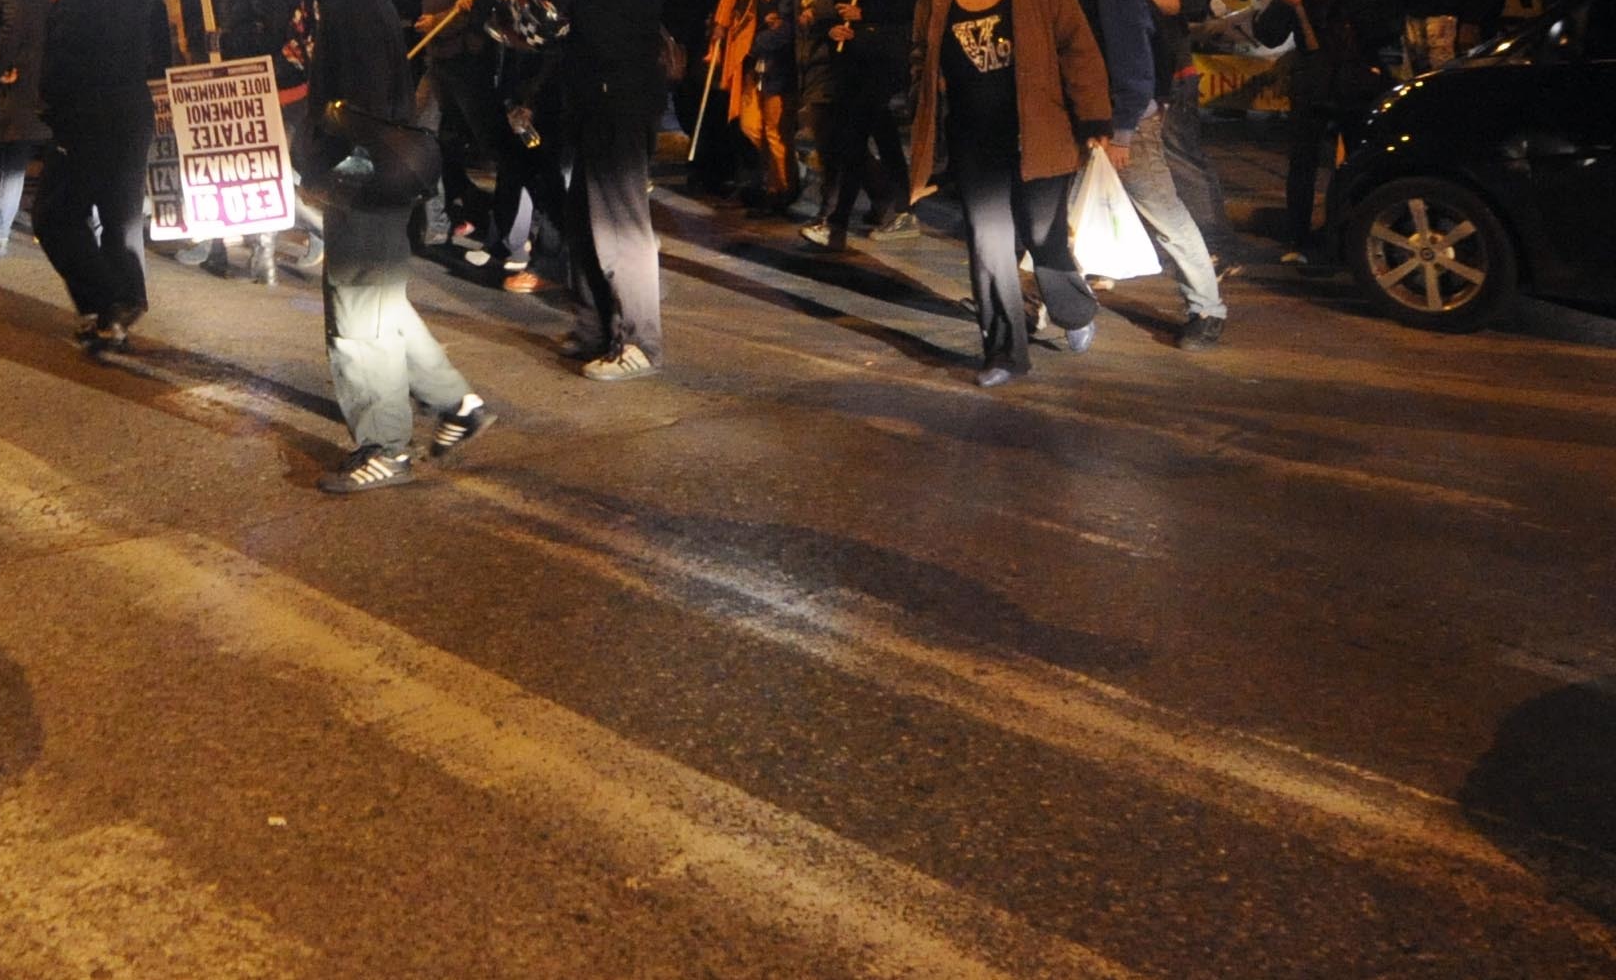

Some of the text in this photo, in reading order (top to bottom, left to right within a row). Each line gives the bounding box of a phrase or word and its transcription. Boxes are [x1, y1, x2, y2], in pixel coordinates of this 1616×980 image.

[172, 77, 272, 104] ΠΟΤΕ ΝΙΚΗΜΕΝΟΙ
[186, 98, 265, 125] ΕΝΩΜΕΝΟΙ
[189, 120, 269, 150] ΕΡΓΑΤΕΣ
[187, 149, 279, 186] ΝΕΟΝΑΖΙ
[220, 180, 285, 224] ΕΞΩ
